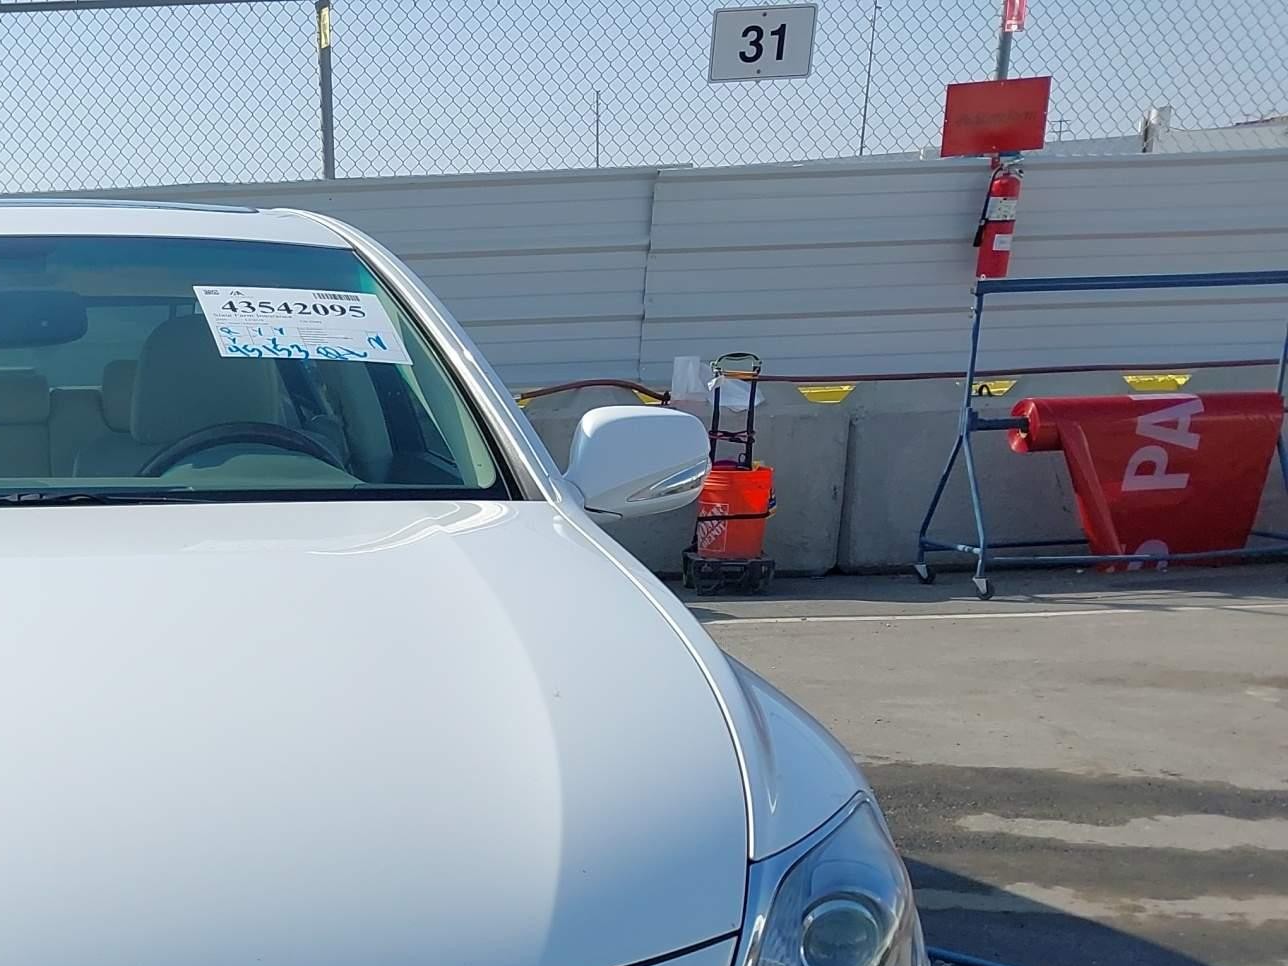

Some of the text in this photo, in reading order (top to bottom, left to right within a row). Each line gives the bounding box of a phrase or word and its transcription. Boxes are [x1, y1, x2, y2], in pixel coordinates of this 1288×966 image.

[738, 23, 787, 63] 31
[221, 300, 366, 318] 43542095
[1121, 393, 1203, 491] PA
